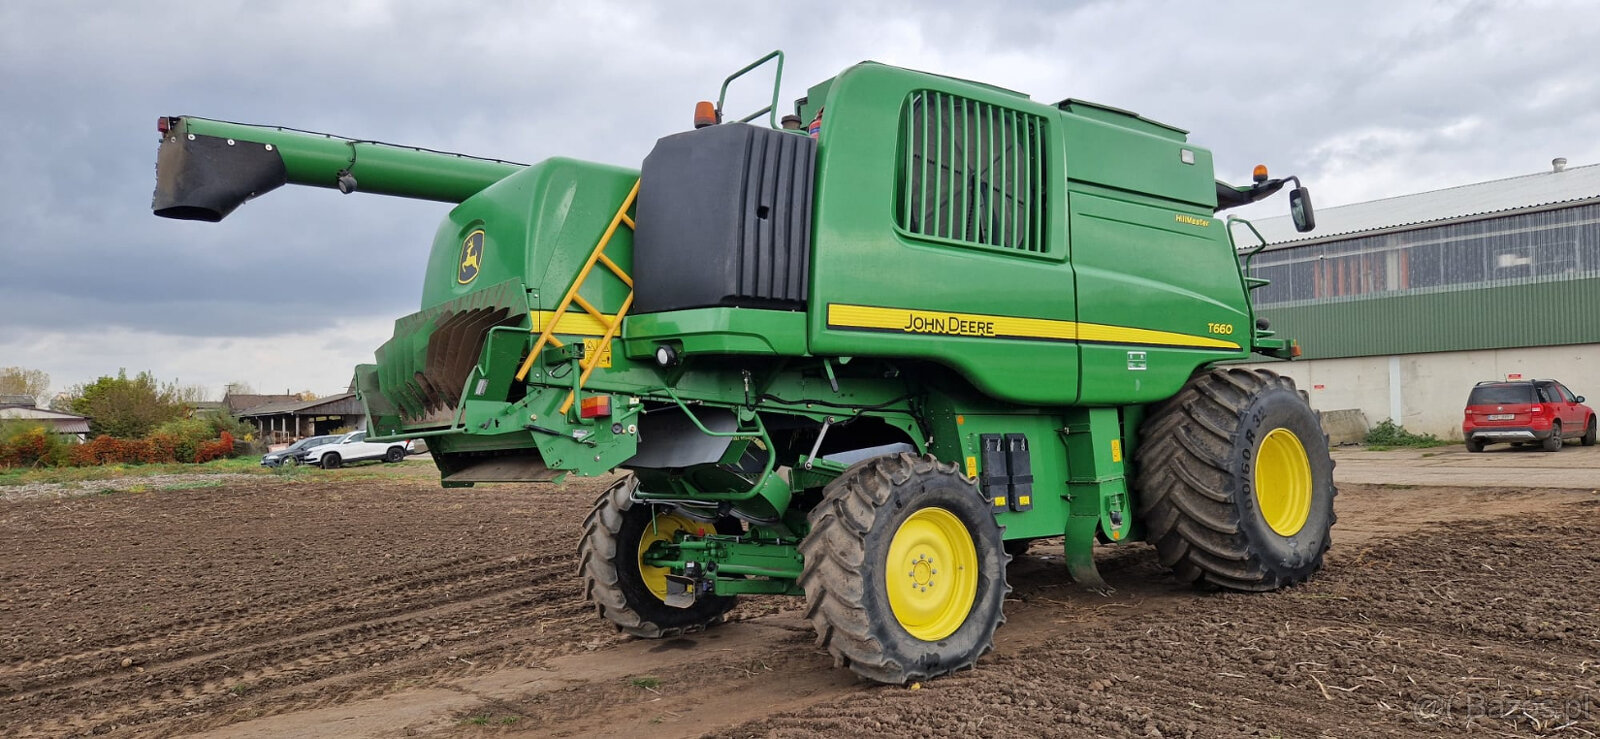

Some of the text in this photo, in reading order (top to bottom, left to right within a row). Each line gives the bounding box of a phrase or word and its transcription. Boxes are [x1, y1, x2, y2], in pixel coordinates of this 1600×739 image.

[1175, 214, 1209, 227] HillMaster
[904, 313, 994, 334] JOHN DEERE
[1208, 322, 1233, 334] T660
[1245, 428, 1256, 447] R
